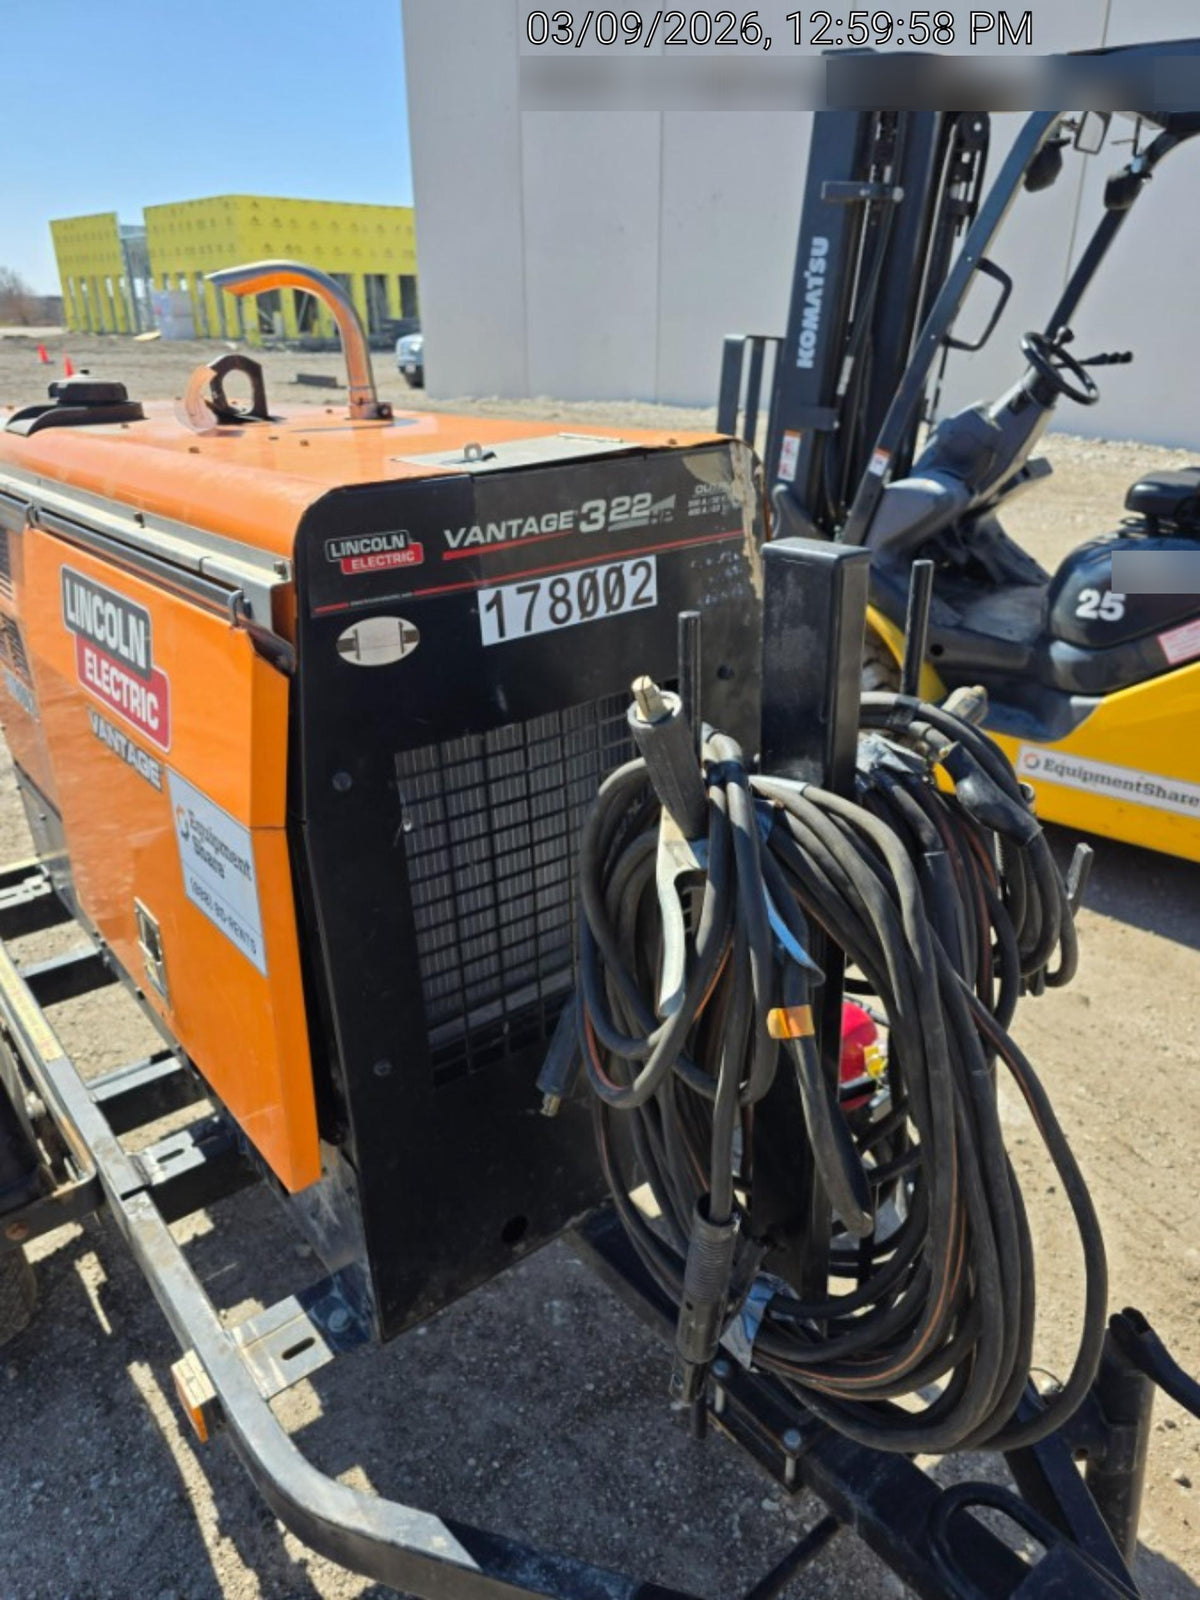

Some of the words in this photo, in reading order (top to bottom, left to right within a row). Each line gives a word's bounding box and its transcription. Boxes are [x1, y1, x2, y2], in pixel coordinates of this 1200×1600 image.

[796, 236, 830, 369] KOMATSU
[329, 533, 407, 558] LINCOLN
[443, 509, 575, 549] VANTAGE
[579, 491, 653, 533] 322
[351, 550, 416, 571] ELECTRIC
[65, 577, 148, 670] LINCOLN
[1075, 587, 1126, 621] 25
[84, 646, 160, 731] ELECTRIC
[87, 704, 165, 794] VANTAGE
[1043, 757, 1200, 808] EquipmentShare
[188, 808, 252, 882] Equipment
